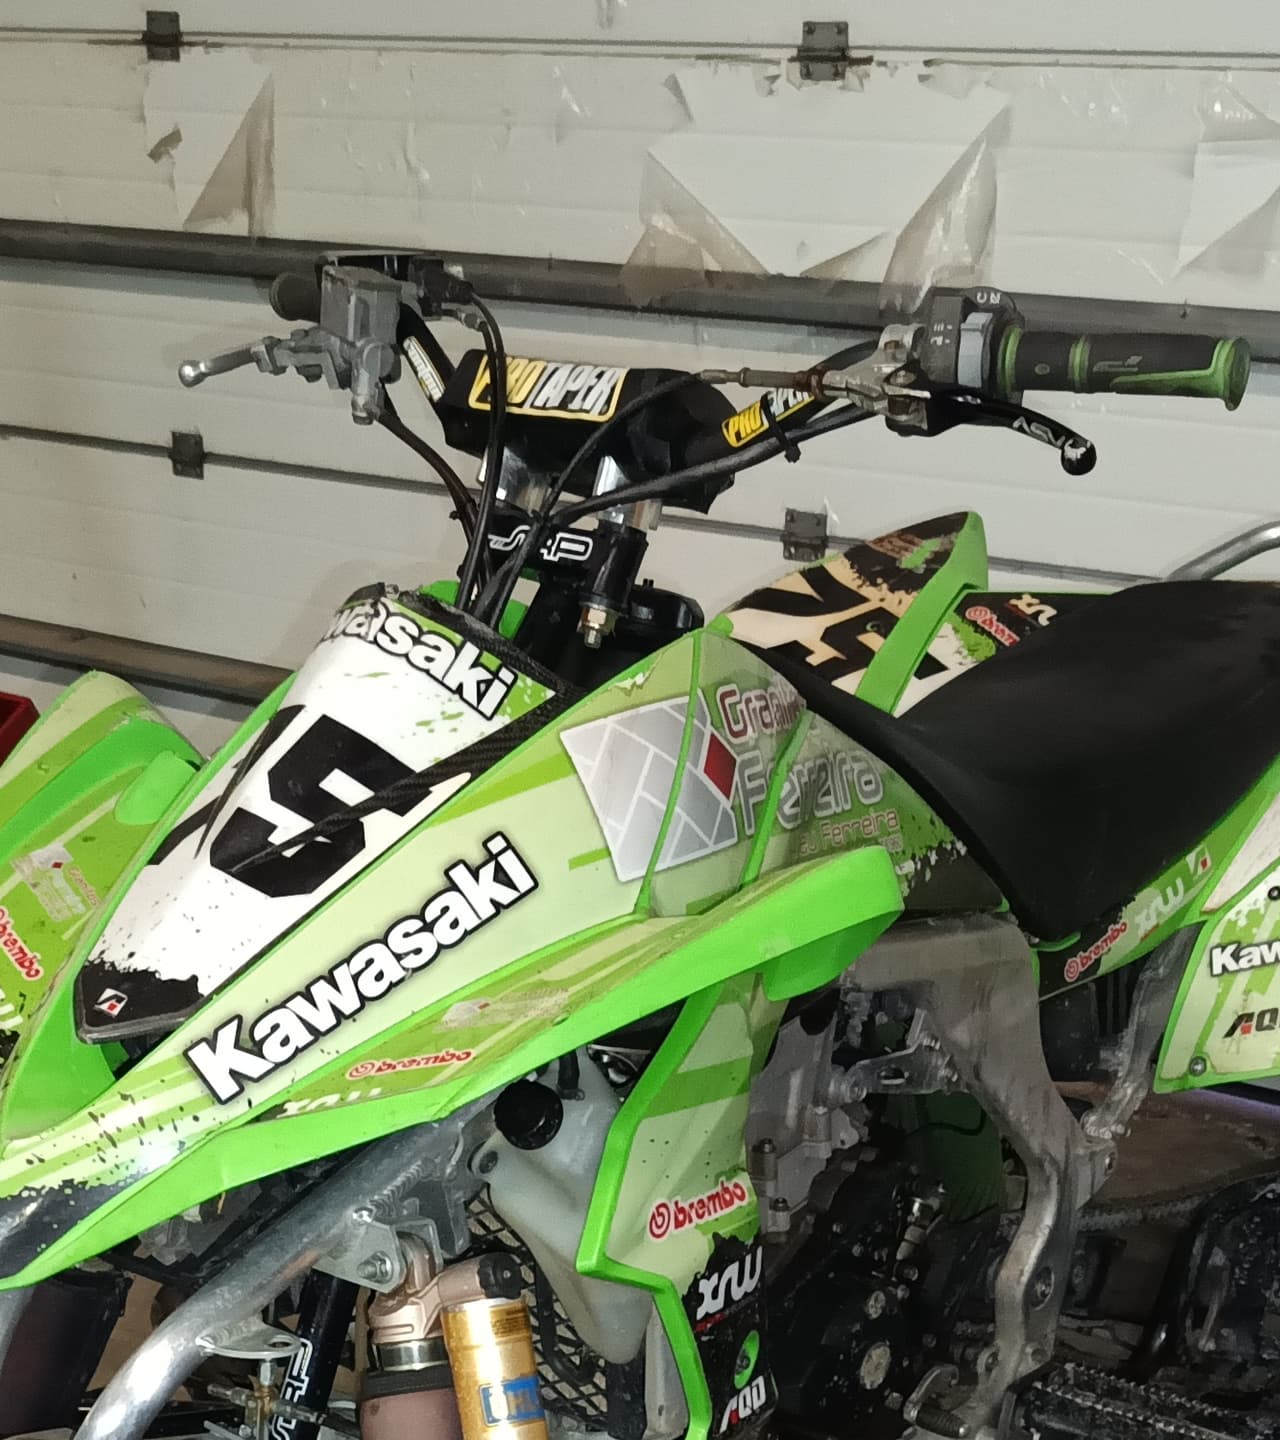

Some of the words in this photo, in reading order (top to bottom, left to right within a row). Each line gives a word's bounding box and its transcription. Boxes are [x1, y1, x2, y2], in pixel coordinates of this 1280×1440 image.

[183, 831, 539, 1104] Kawasaki
[1079, 921, 1128, 969] brembo
[673, 1179, 747, 1230] brembo
